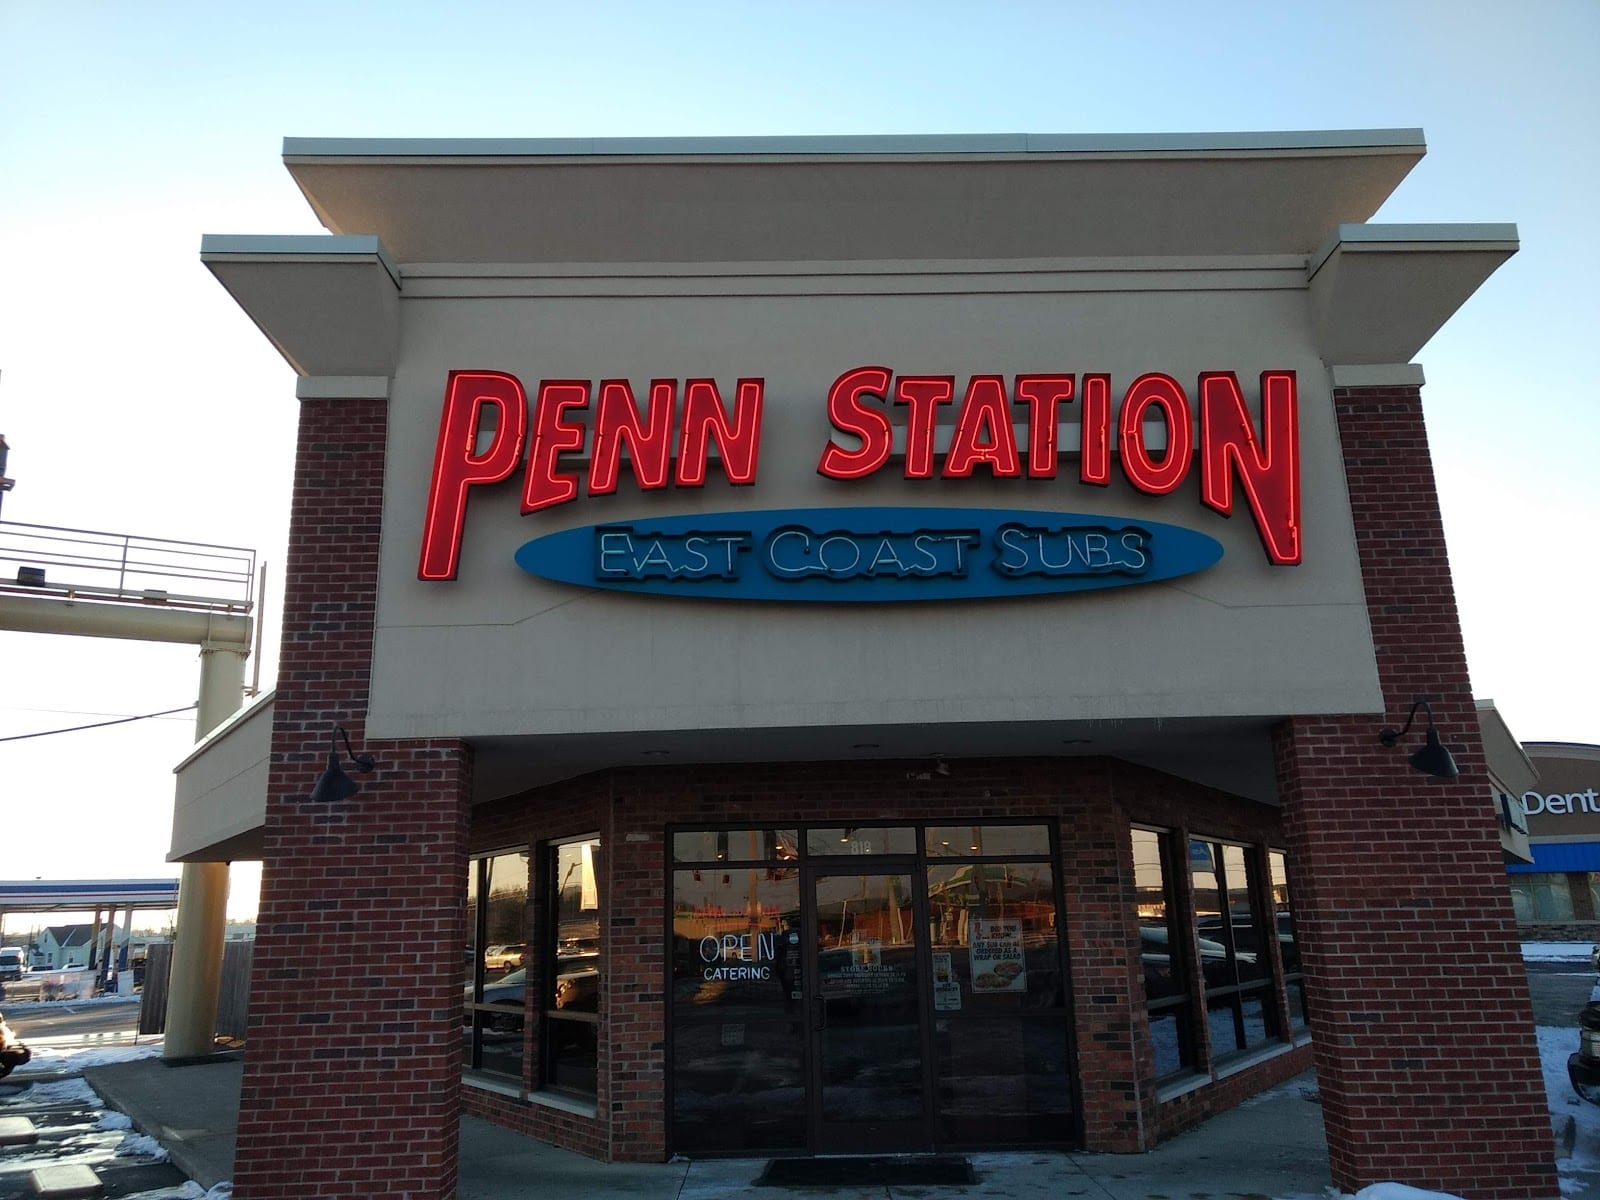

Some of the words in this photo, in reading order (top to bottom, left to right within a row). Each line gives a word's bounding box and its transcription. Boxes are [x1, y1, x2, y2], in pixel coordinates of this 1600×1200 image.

[417, 369, 765, 582] PENN
[816, 366, 1302, 566] STATION
[597, 527, 751, 578] EAST
[766, 526, 979, 577] COAST
[994, 523, 1151, 576] SUBS
[850, 840, 872, 855] 818
[699, 932, 775, 963] OPEN
[703, 966, 770, 981] CATERING
